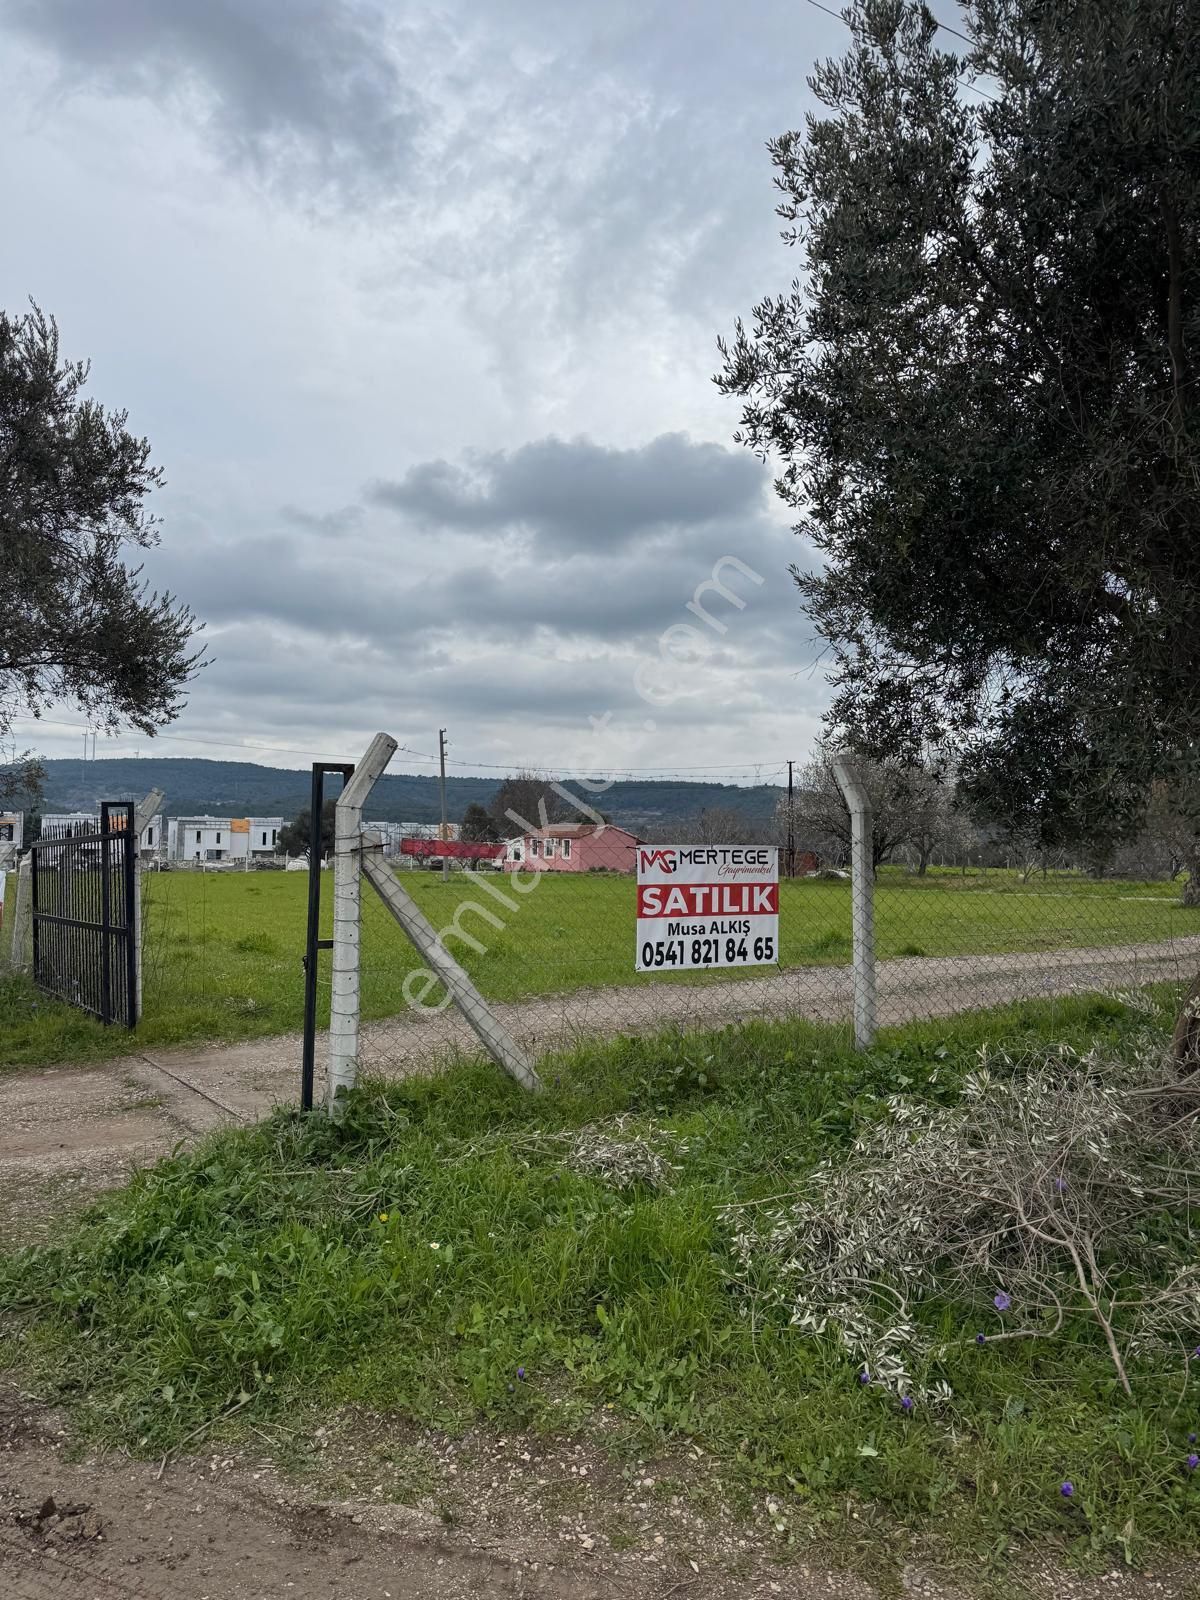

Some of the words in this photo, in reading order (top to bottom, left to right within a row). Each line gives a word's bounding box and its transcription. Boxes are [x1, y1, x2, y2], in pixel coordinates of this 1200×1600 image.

[679, 849, 769, 864] MERTEGE
[718, 863, 775, 880] Gayrimenkul
[642, 886, 774, 915] SATILIK
[667, 922, 706, 937] Musa
[709, 920, 751, 936] ALKIŞ
[642, 940, 685, 967] 0541
[691, 938, 719, 964] 821
[725, 937, 749, 962] 84
[753, 936, 774, 961] 65
